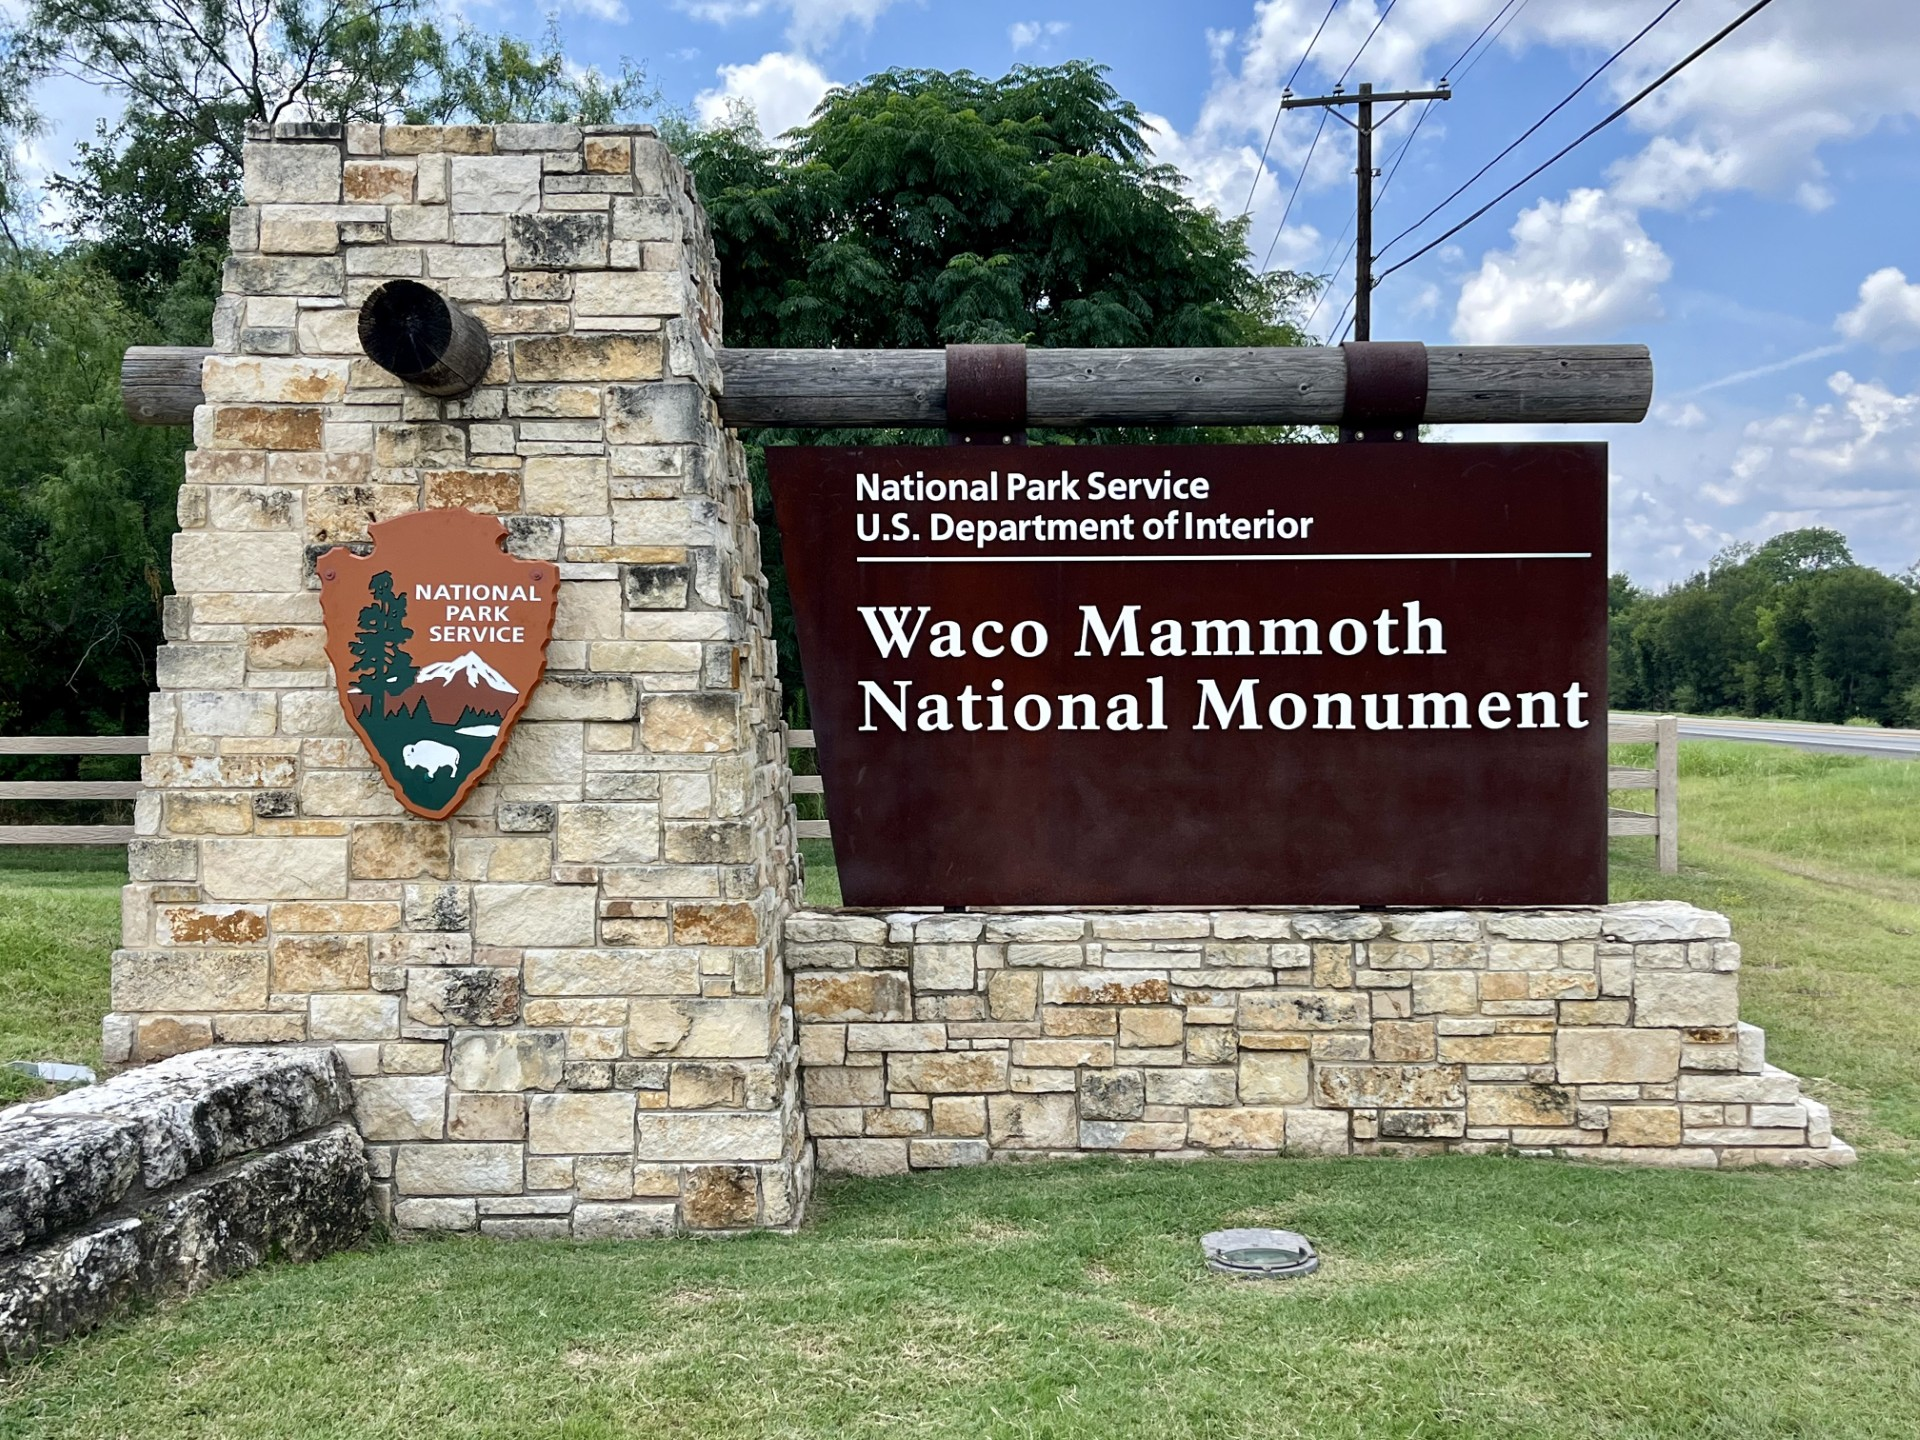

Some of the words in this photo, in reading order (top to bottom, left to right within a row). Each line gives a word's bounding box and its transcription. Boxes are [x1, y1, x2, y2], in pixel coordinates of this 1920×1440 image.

[856, 471, 998, 502] National
[1007, 471, 1081, 501] Park
[1087, 470, 1210, 501] Service
[856, 513, 920, 542] U.S.
[930, 513, 1135, 549] Department
[1142, 510, 1180, 540] of
[1185, 510, 1314, 540] Interior
[415, 584, 542, 602] NATIONAL
[446, 605, 510, 622] PARK
[857, 606, 1048, 659] Waco
[1073, 600, 1447, 657] Mammoth
[429, 626, 525, 643] SERVICE
[857, 676, 1168, 732] National
[1192, 678, 1590, 731] Monument
